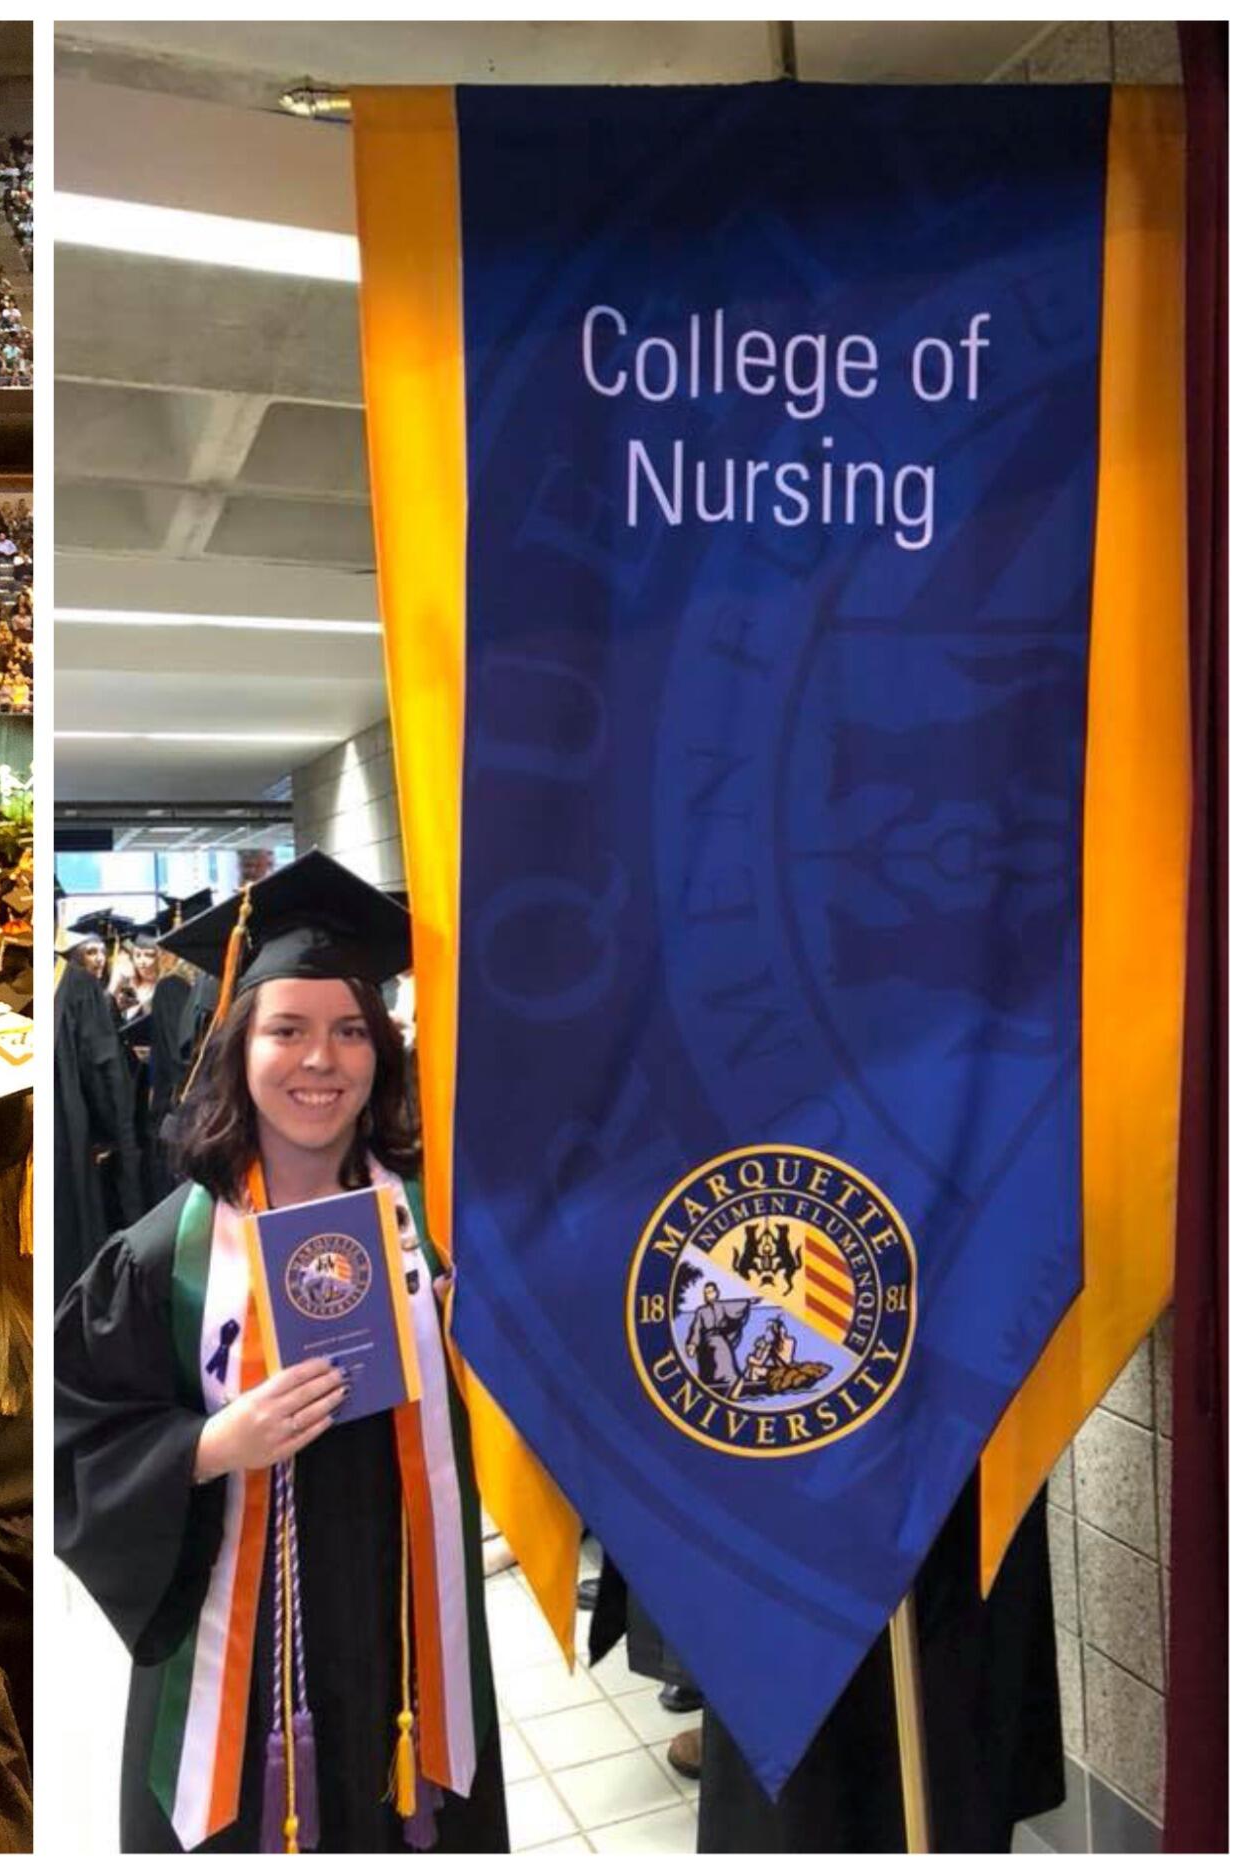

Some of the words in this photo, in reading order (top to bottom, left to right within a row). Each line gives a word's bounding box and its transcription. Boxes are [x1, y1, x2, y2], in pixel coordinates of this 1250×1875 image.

[580, 304, 879, 418] College
[910, 311, 991, 402] of
[625, 436, 938, 551] Nursing
[652, 1157, 900, 1260] MARQUETTE
[638, 1294, 665, 1324] 18
[885, 1285, 908, 1313] 81
[700, 1196, 787, 1248] NUMEN
[795, 1197, 876, 1348] FLUMENQUE
[652, 1339, 900, 1444] UNIVERSITY
